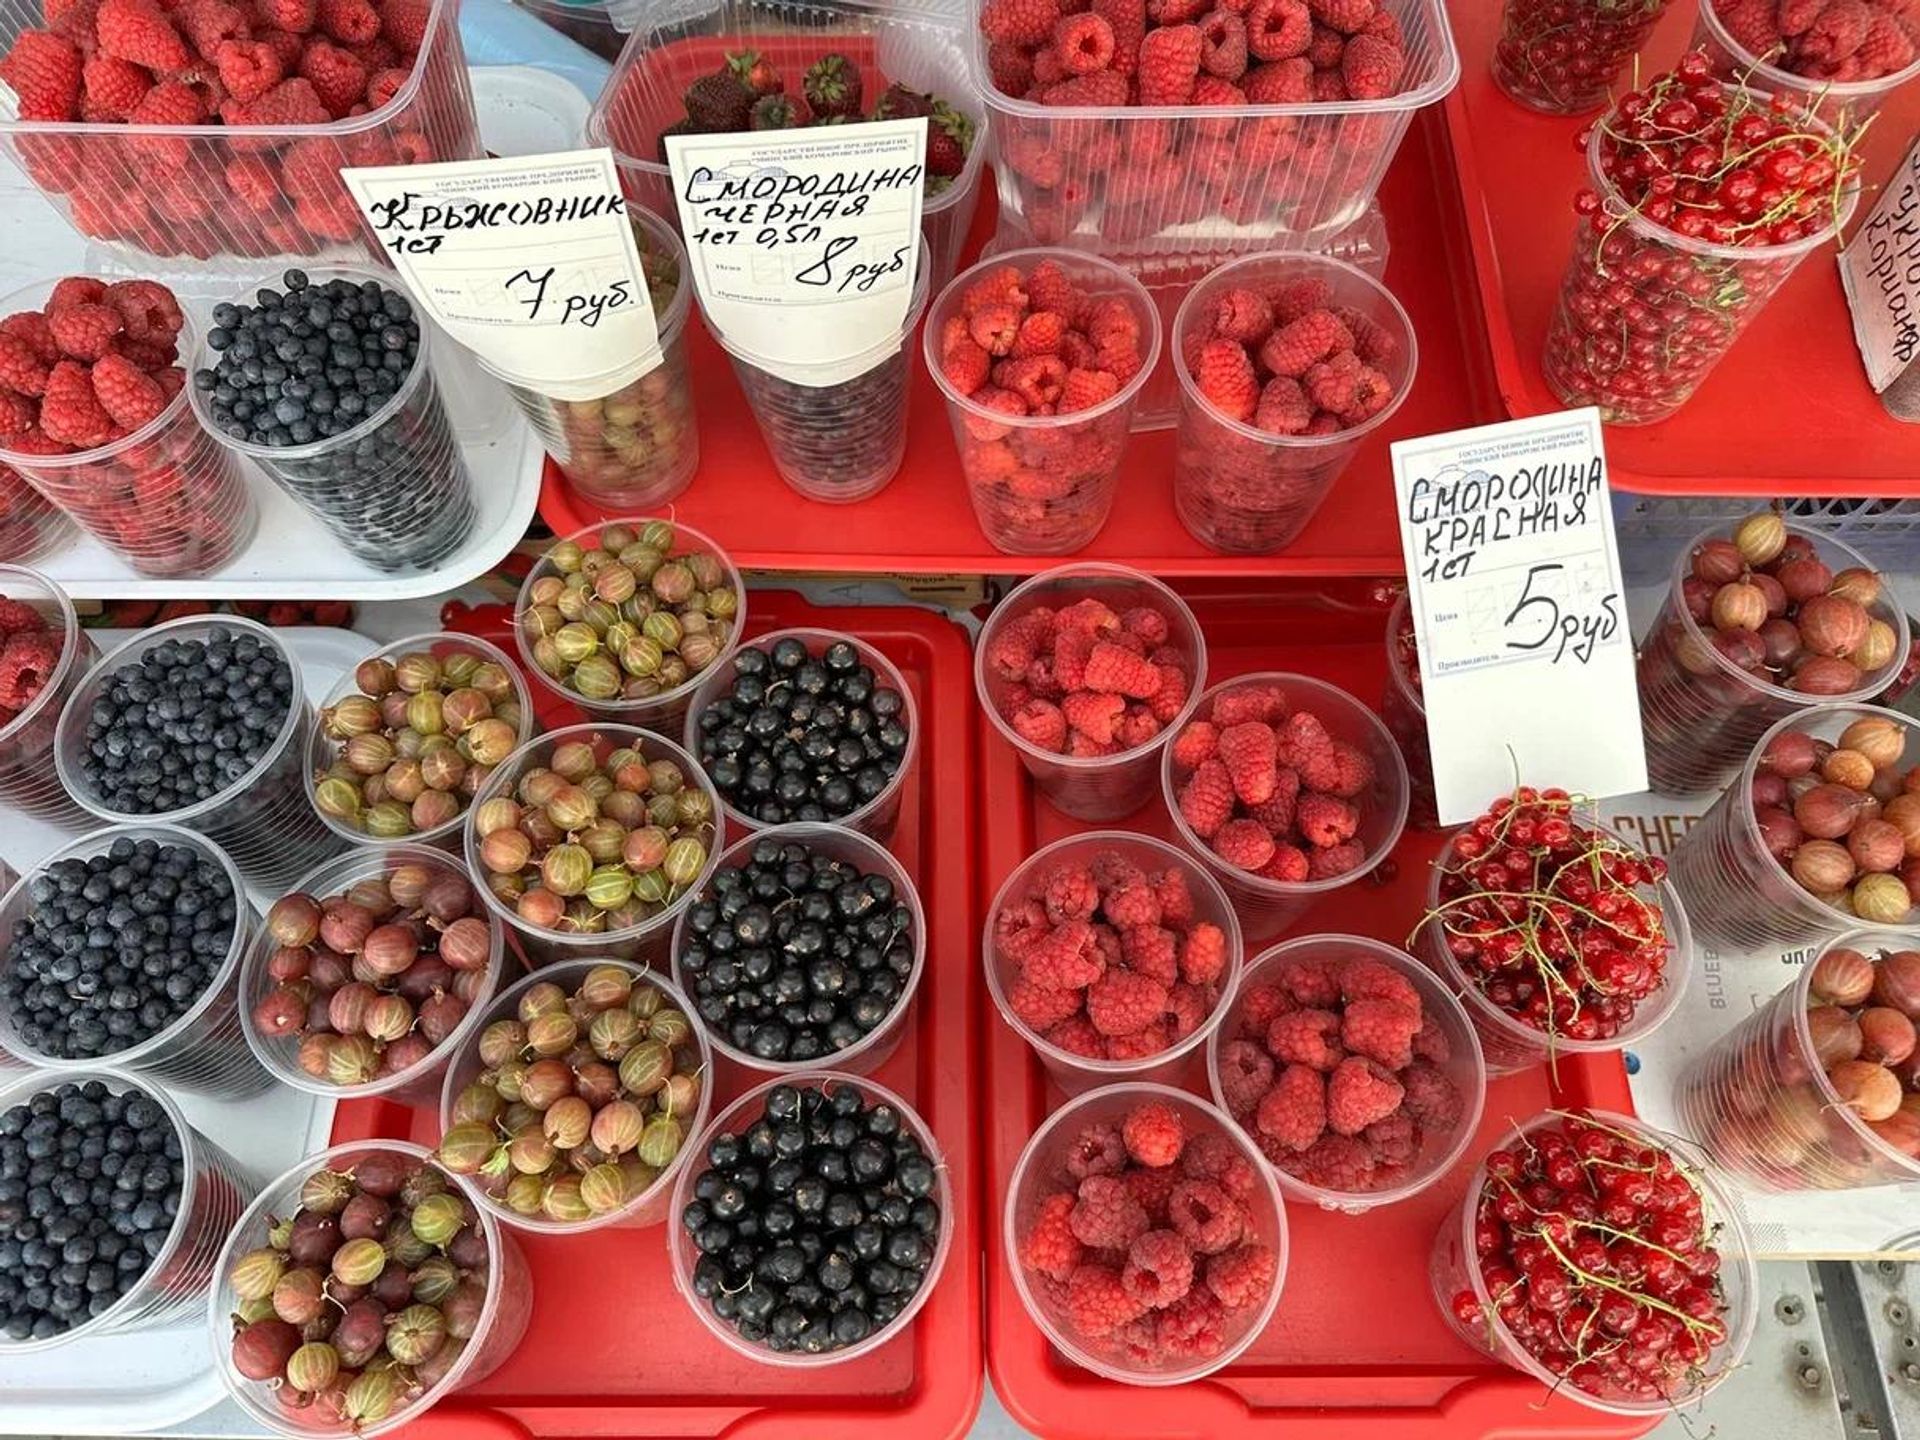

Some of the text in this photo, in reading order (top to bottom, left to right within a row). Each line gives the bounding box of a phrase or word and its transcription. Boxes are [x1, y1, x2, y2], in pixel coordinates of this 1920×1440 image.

[796, 236, 858, 286] 8
[1504, 564, 1618, 664] 5 руб
